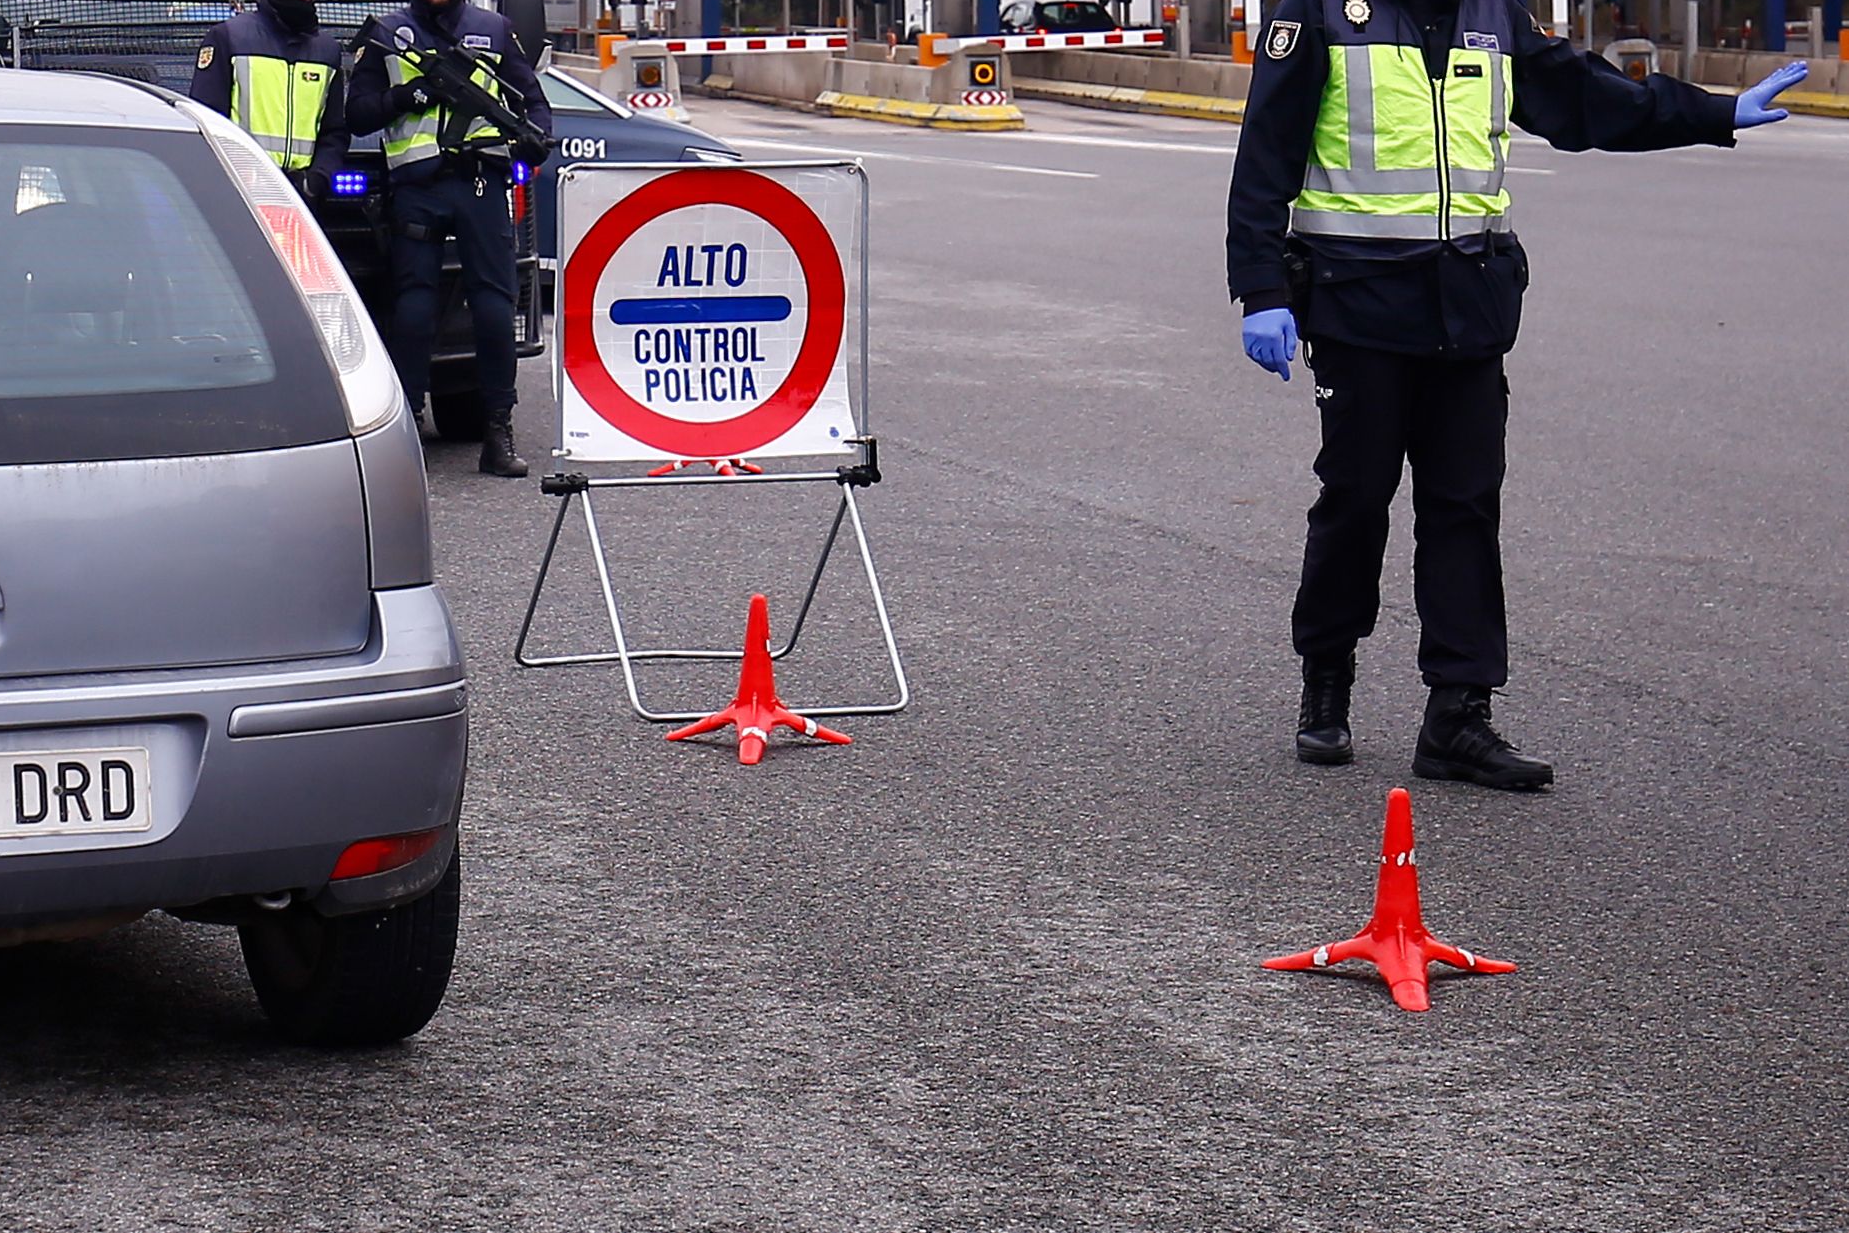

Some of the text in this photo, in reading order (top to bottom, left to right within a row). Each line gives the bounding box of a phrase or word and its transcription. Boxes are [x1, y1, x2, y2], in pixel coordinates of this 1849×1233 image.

[657, 243, 748, 288] ALTO
[634, 327, 766, 364] CONTROL
[645, 366, 758, 402] POLICIA
[13, 760, 135, 825] DRD
